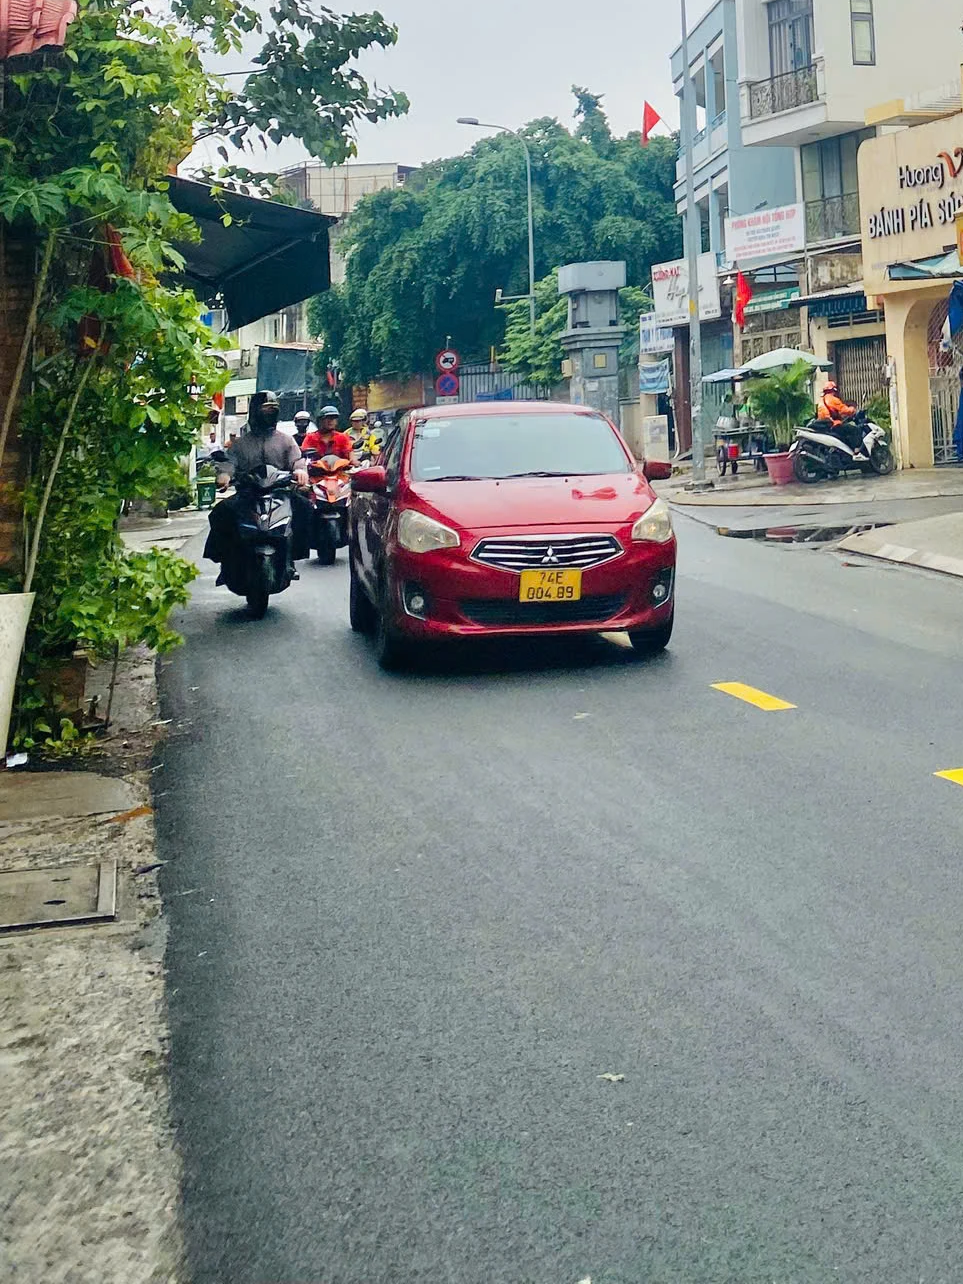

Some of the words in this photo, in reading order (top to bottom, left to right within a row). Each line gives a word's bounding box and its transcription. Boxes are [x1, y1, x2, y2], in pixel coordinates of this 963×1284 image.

[868, 207, 906, 239] BÁNH
[909, 198, 934, 231] PÍA
[540, 571, 564, 585] 74E
[527, 586, 574, 600] 004.89
